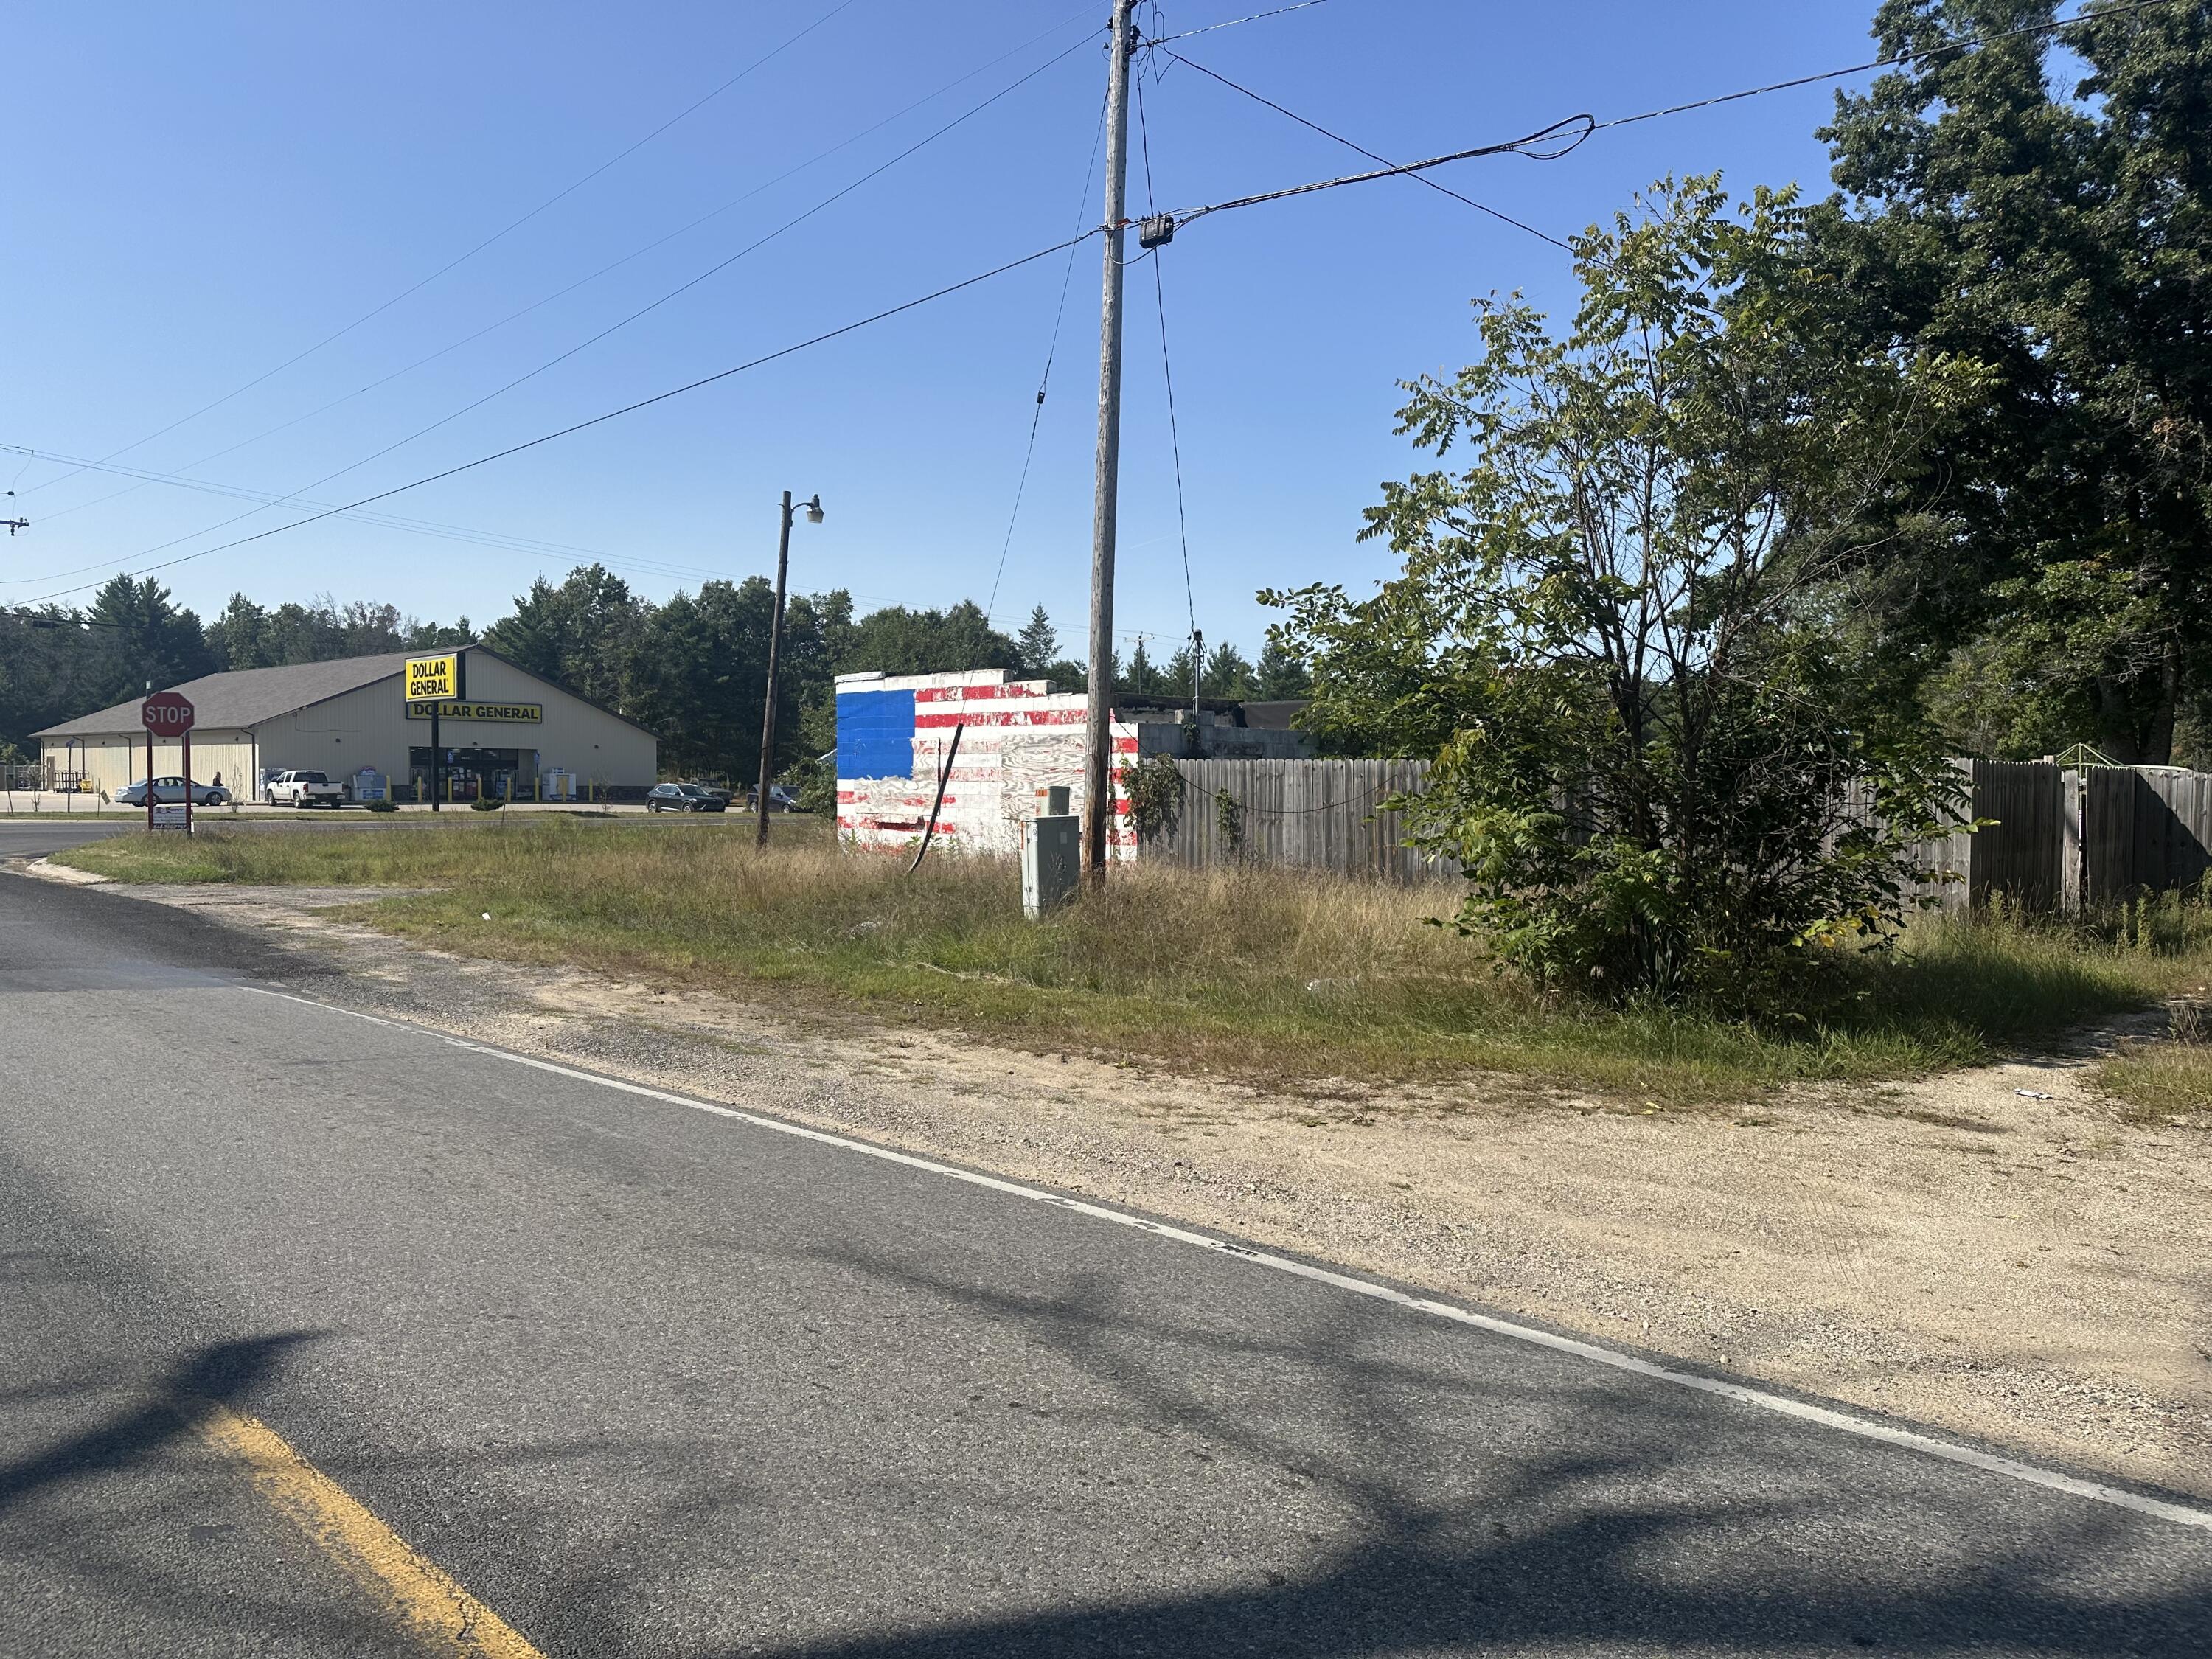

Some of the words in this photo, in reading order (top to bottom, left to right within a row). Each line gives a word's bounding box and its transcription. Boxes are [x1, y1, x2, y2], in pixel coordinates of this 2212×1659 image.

[413, 661, 446, 678] DOLLAR
[411, 678, 449, 696] GENERAL
[145, 706, 191, 723] STOP
[476, 706, 538, 720] GENERAL
